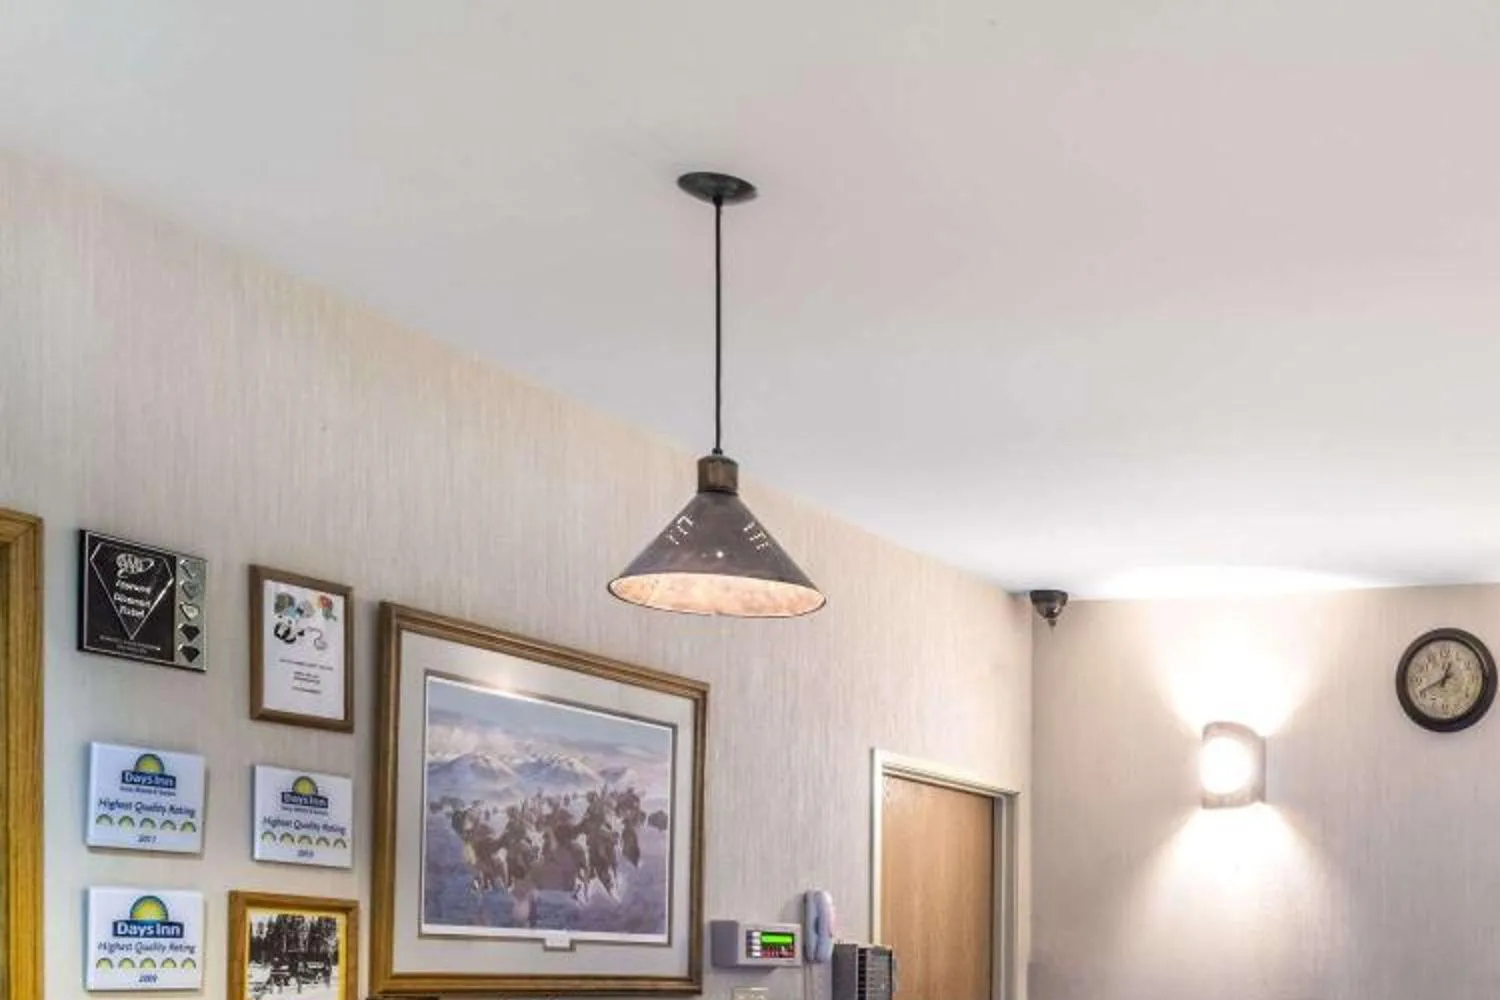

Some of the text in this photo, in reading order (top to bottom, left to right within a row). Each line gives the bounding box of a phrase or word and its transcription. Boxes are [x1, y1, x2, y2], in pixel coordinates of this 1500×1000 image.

[98, 797, 132, 811] Highest
[134, 802, 166, 816] Quality
[117, 922, 181, 936] Days Inn
[98, 941, 196, 954] Highest Quality Rating
